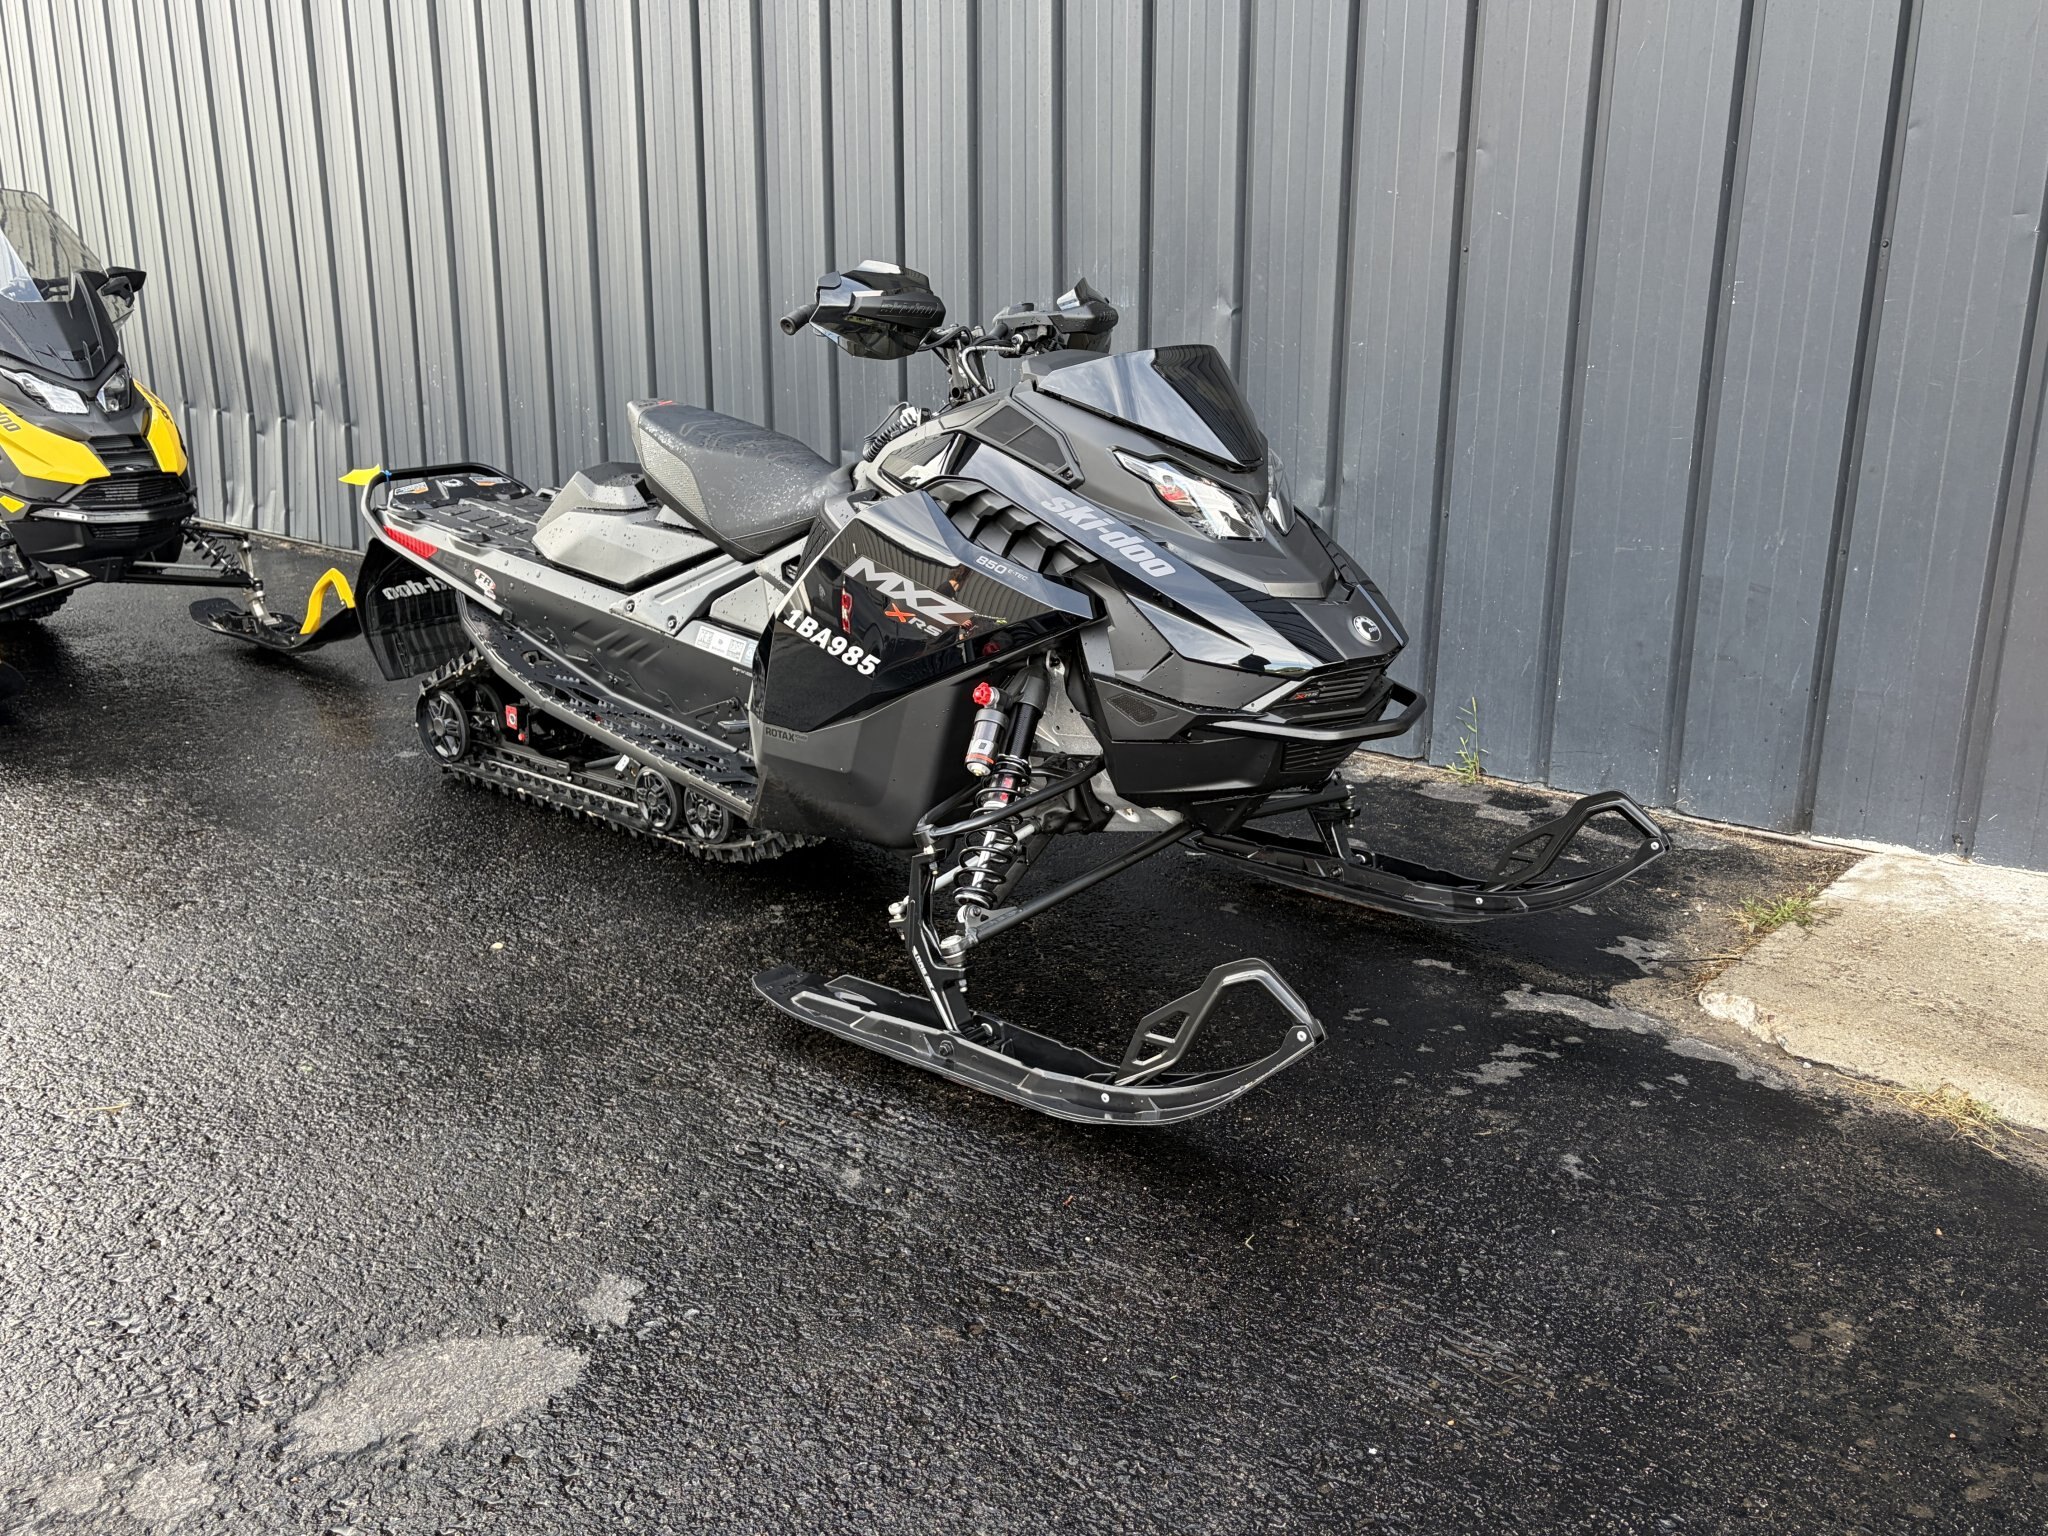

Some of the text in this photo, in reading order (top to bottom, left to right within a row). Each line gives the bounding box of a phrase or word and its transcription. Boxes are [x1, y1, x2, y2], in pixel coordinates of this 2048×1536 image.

[975, 555, 1007, 574] 850
[1041, 497, 1176, 577] ski-doo
[843, 556, 975, 625] MXZ
[783, 609, 881, 675] 1BA985
[765, 726, 795, 742] ROTAX
